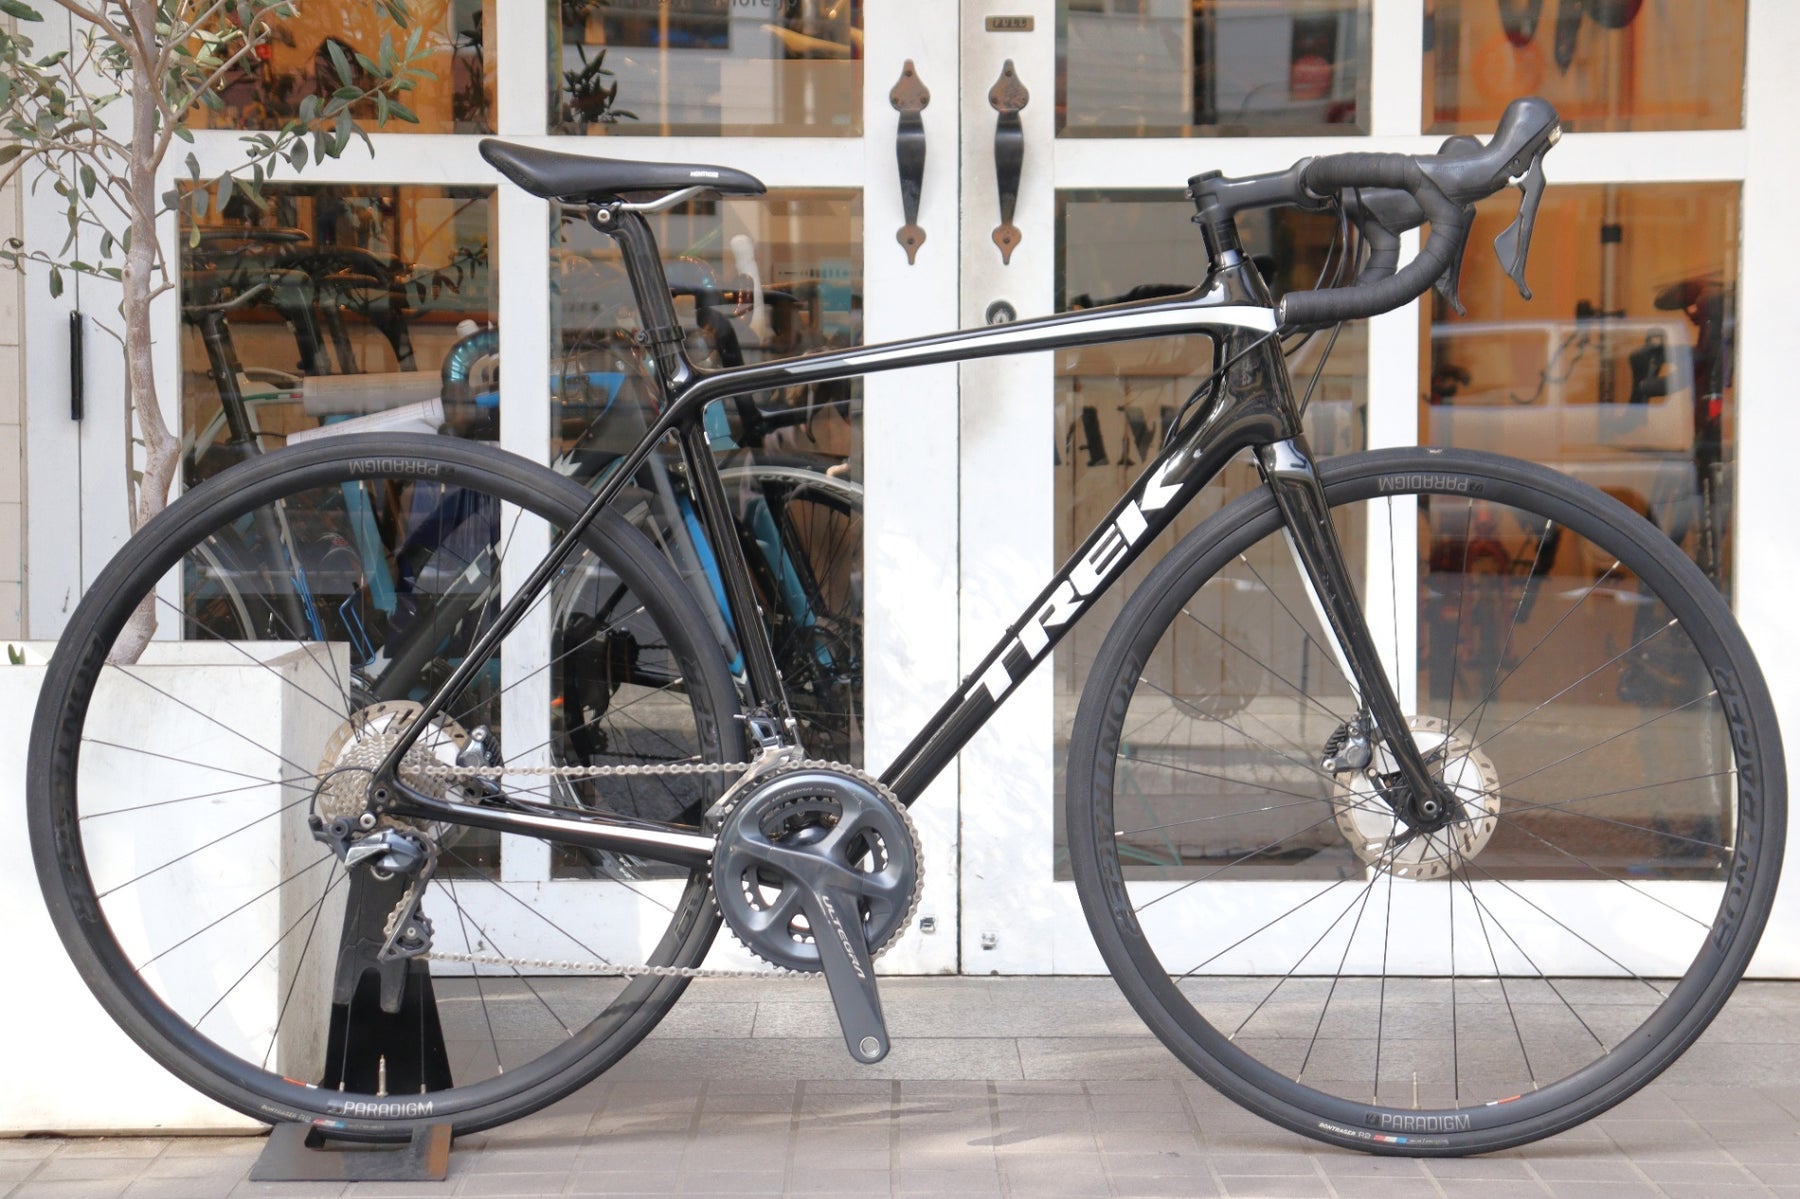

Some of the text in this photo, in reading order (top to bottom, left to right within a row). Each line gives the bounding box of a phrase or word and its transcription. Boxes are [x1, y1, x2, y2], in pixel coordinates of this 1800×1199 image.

[348, 459, 439, 476] PARADIGM
[1379, 475, 1469, 492] PARADIGM
[964, 458, 1184, 702] TREK
[1709, 665, 1758, 955] BONTRAGER
[822, 895, 866, 979] ULTEGRA
[343, 1101, 433, 1117] PARADIGM
[1381, 1113, 1471, 1131] PARADIGM
